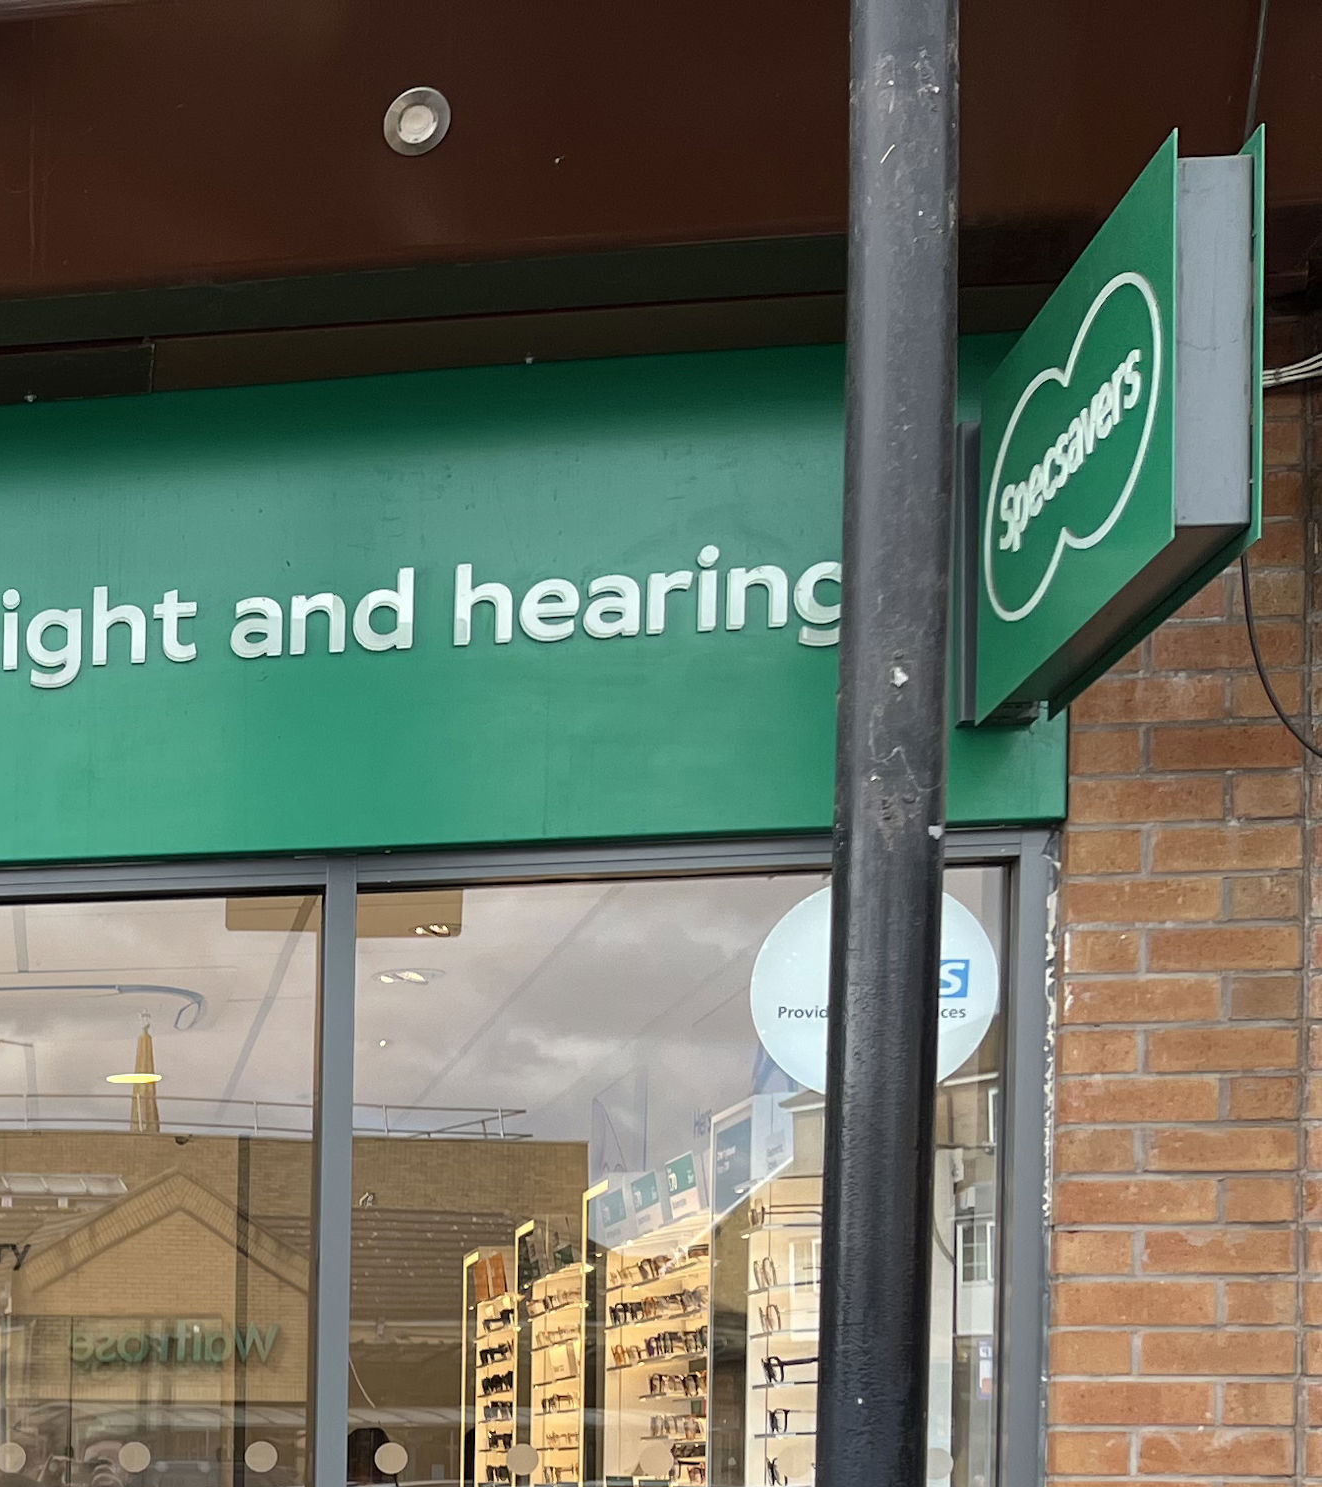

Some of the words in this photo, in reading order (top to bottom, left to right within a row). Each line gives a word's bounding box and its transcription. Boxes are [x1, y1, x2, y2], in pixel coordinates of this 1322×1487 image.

[999, 349, 1141, 552] Specsavers
[230, 567, 415, 659] and
[453, 544, 842, 648] hearing
[778, 1005, 828, 1019] Provid
